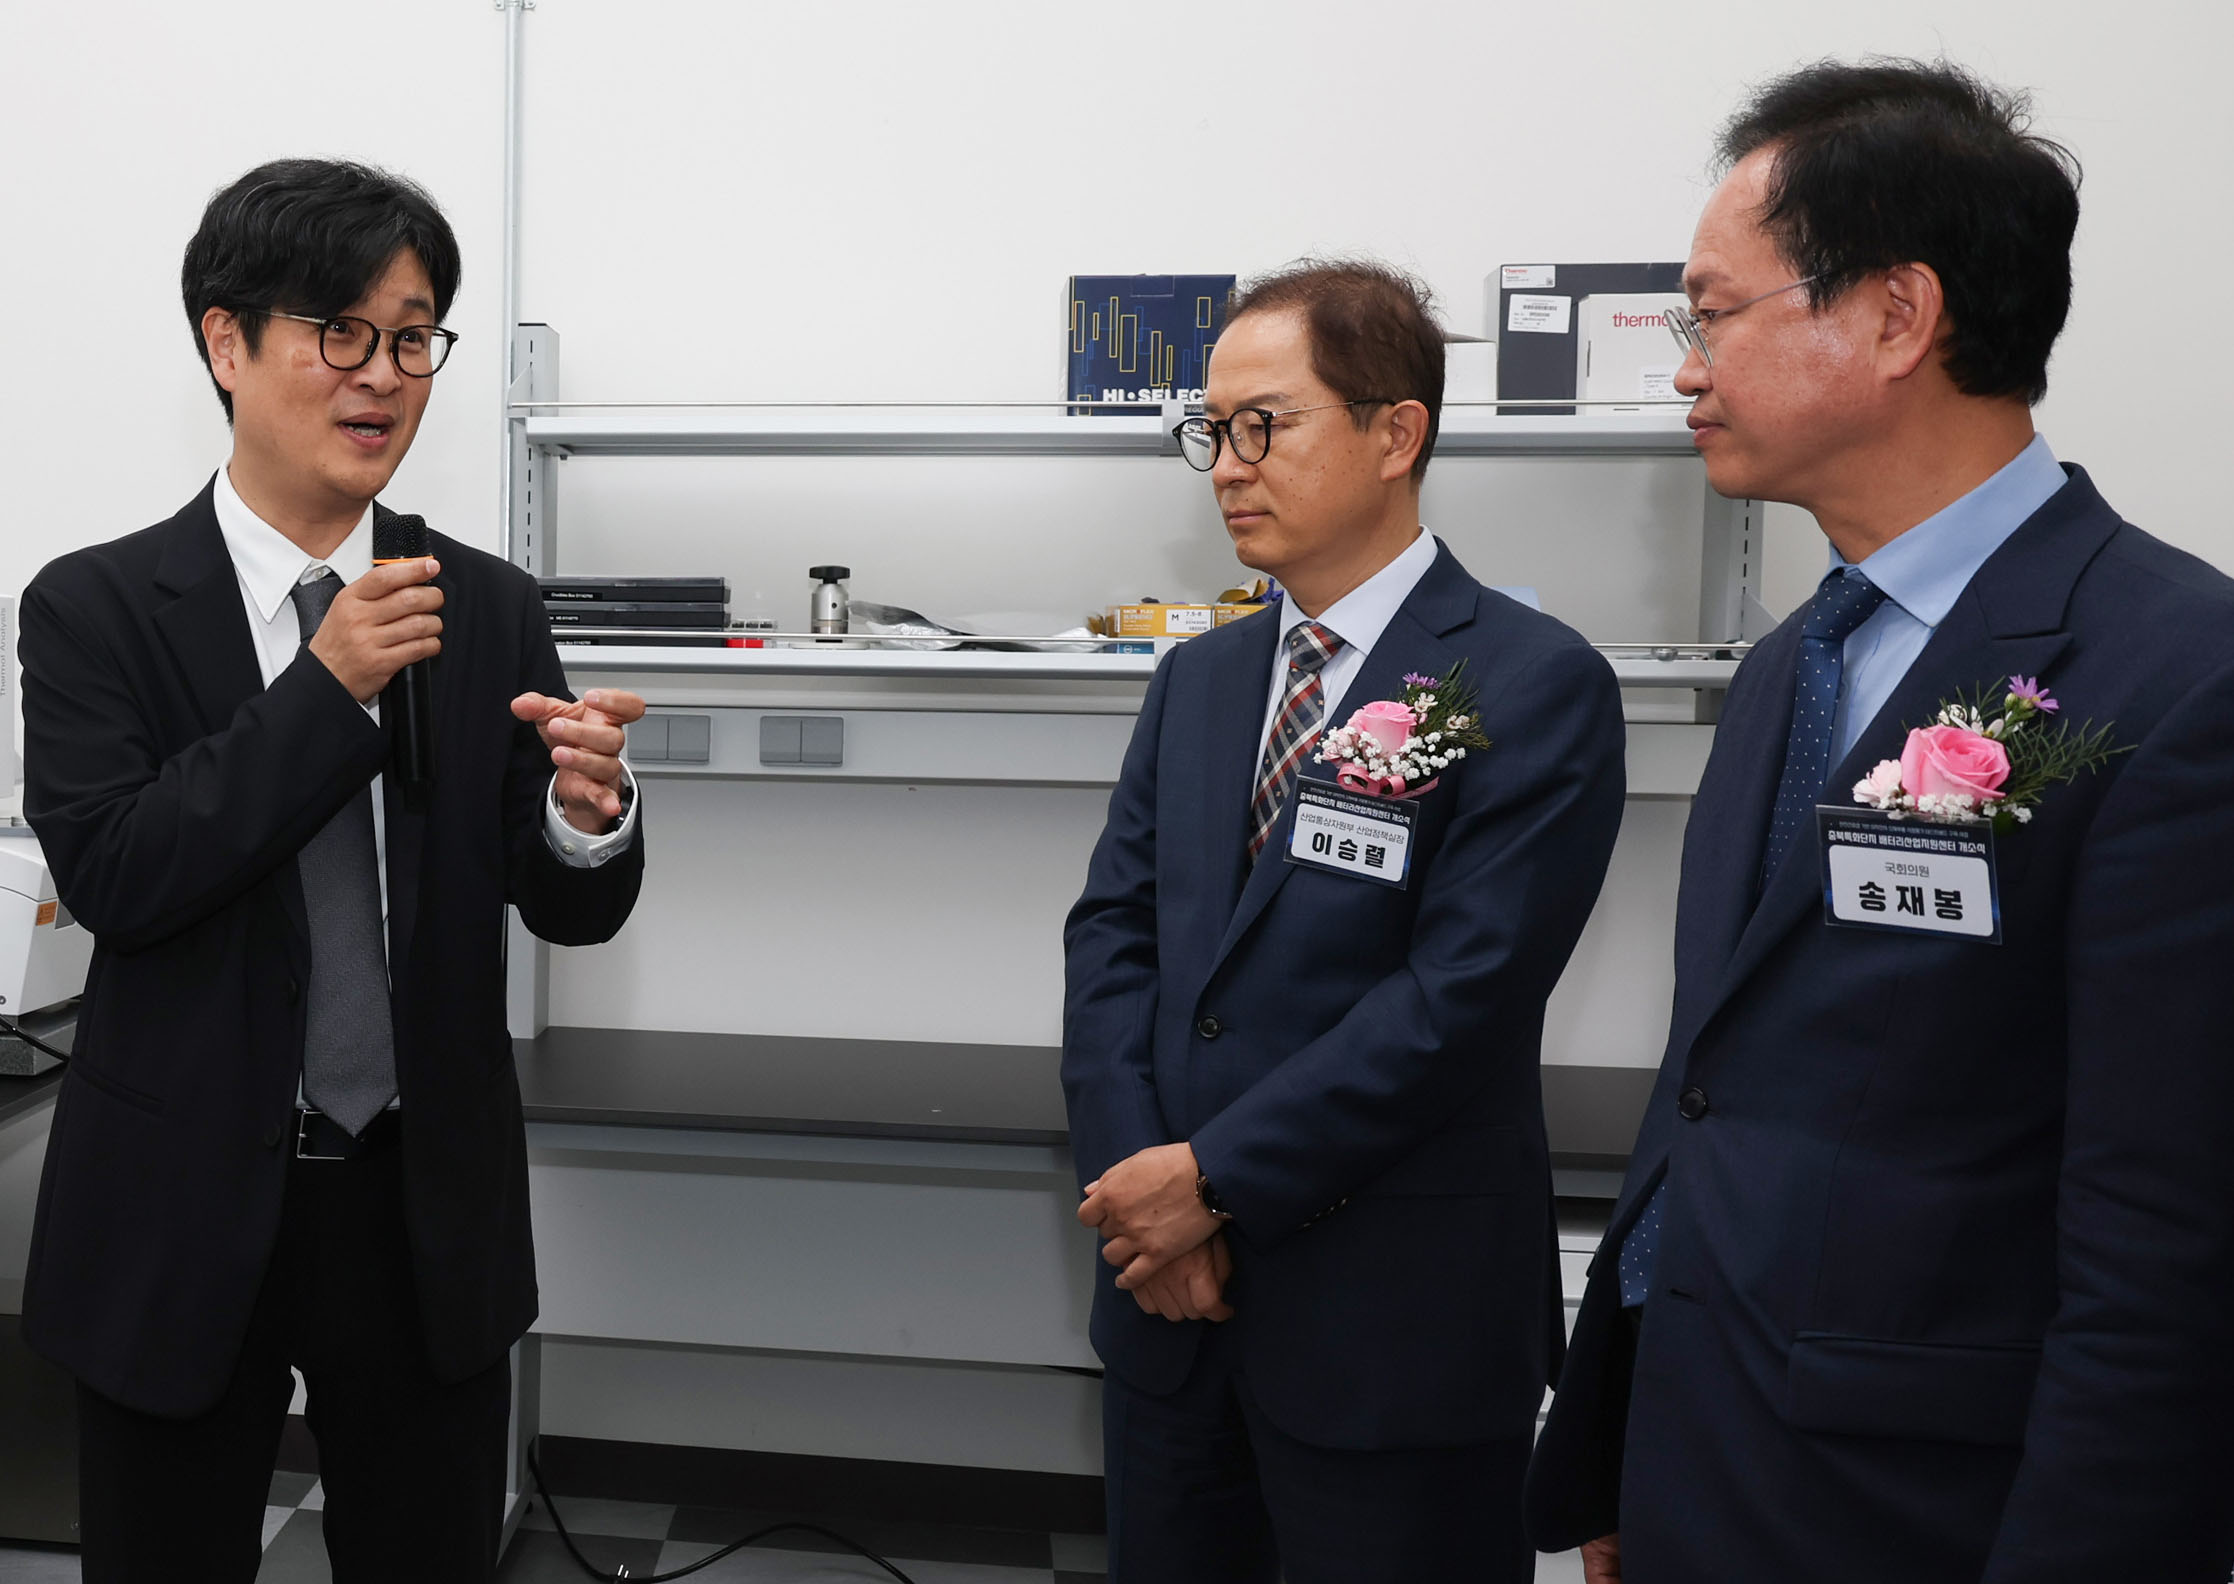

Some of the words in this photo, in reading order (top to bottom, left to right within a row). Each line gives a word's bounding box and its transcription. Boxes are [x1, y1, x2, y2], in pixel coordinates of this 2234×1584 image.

[1103, 388, 1207, 402] HI•SELEC
[1171, 613, 1179, 621] M
[1300, 812, 1354, 832] 산업통상자원부
[1356, 826, 1404, 844] 산업정책실장
[1312, 832, 1385, 868] 이승렬
[1959, 841, 1986, 855] 개소식
[1884, 861, 1930, 878] 국회의원
[1858, 881, 1964, 921] 송재봉
